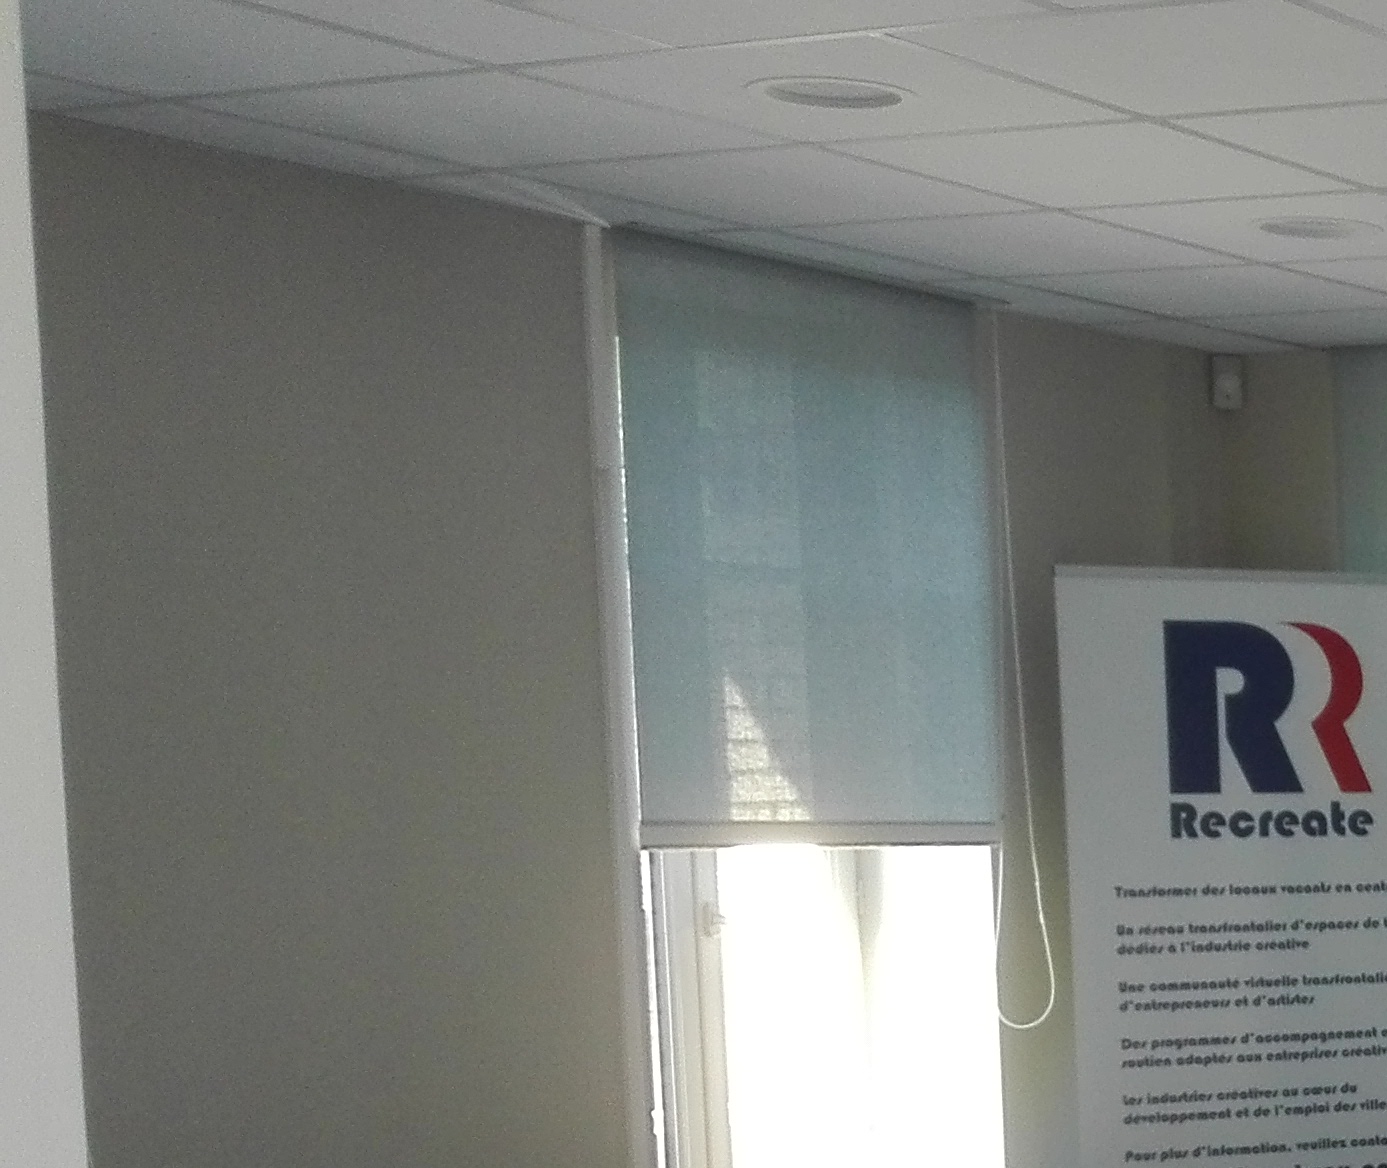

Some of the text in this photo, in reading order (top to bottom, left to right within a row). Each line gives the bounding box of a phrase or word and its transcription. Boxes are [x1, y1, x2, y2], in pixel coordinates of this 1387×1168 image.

[1170, 800, 1376, 840] Recreate
[1114, 885, 1198, 899] Transformer
[1201, 883, 1225, 897] des
[1281, 881, 1331, 895] vacants
[1335, 883, 1352, 893] en
[1116, 924, 1134, 936] Un
[1188, 920, 1287, 935] transfrontalier
[1363, 916, 1380, 930] de
[1244, 974, 1299, 990] virtuelle
[1235, 995, 1249, 1008] et
[1121, 1038, 1147, 1050] Des
[1151, 1034, 1237, 1051] programmes
[1236, 1052, 1262, 1063] aux
[1266, 1048, 1338, 1063] entreprises
[1147, 1089, 1213, 1105] industries
[1282, 1086, 1299, 1098] au
[1340, 1082, 1358, 1094] du
[1235, 1106, 1250, 1119] et
[1253, 1104, 1271, 1118] de
[1334, 1100, 1357, 1113] des
[1124, 1149, 1157, 1163] Pour
[1160, 1147, 1189, 1163] plus
[1295, 1137, 1347, 1152] veuillez
